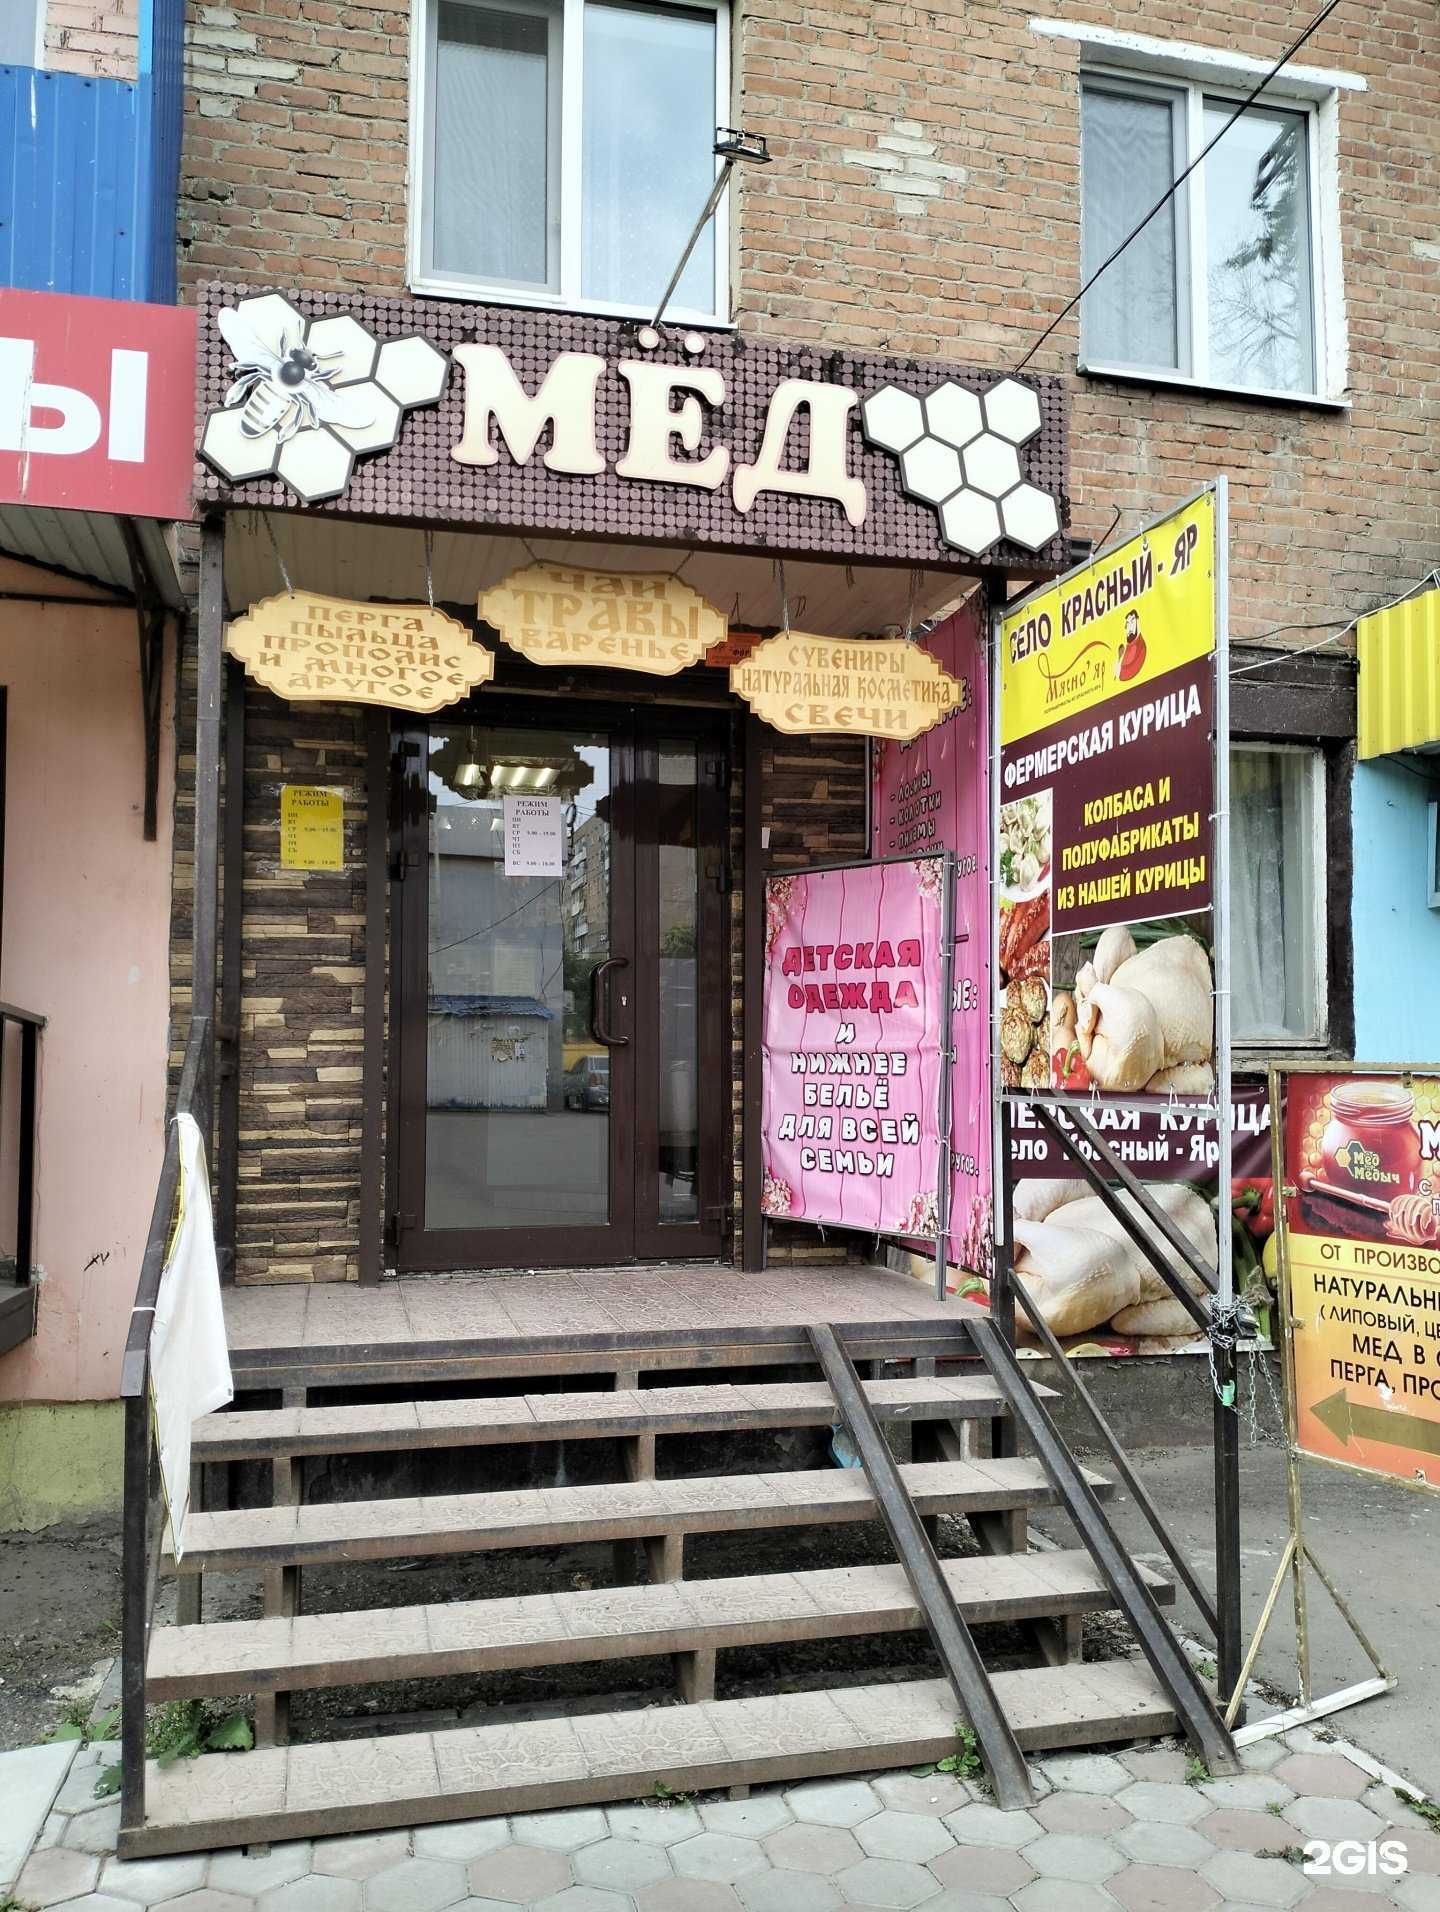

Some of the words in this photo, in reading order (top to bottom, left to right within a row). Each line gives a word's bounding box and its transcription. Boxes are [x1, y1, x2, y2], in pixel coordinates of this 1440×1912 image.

[450, 327, 867, 526] МЁД
[1010, 612, 1052, 664] СЕЛО
[1061, 542, 1153, 637] КРАСНЫЙ
[1170, 523, 1198, 576] ЯР
[307, 605, 424, 632] ПЕРГА
[512, 590, 699, 640] ТРАВЫ
[263, 635, 461, 669] ПРОПОЛИС
[290, 621, 439, 650] ПЫЛЬЦА
[520, 628, 689, 661] ВАРЕНЬЕ
[259, 652, 282, 667] И
[305, 656, 464, 685] МНОГОЕ
[788, 646, 905, 673] СУВЕНИРЫ
[289, 672, 433, 699] ДРУГОЕ
[741, 668, 850, 698] НАТУРАЛЬНАЯ
[858, 676, 950, 704] КОСМЕТИКА
[785, 703, 908, 730] СВЕЧИ
[1004, 720, 1114, 788] ФЕРМЕРСКАЯ
[1119, 684, 1201, 745] КУРИЦА
[1084, 782, 1154, 826] КОЛБАСА
[1159, 776, 1171, 804] И
[1062, 812, 1199, 871] ПОЛУФАБРИКАТЫ
[1057, 884, 1074, 910] ИЗ
[1079, 867, 1131, 906] НАШЕЙ
[1135, 856, 1206, 894] КУРИЦЫ
[782, 939, 921, 976] ДЕТСКАЯ
[788, 980, 919, 1013] ОДЕЖДА
[835, 1022, 856, 1044] И
[790, 1052, 907, 1075] НИЖНЕЕ
[804, 1077, 889, 1109] БЕЛЬЁ
[778, 1114, 833, 1141] ДЛЯ
[841, 1113, 920, 1145] ВСЕЙ
[800, 1147, 894, 1177] СЕМЬИ
[1320, 1243, 1341, 1261] ОТ
[1313, 1273, 1440, 1312] НАТУРАЛЬН
[1352, 1333, 1403, 1365] МЕД
[1414, 1344, 1426, 1365] В
[1330, 1359, 1396, 1394] ПЕРГА,
